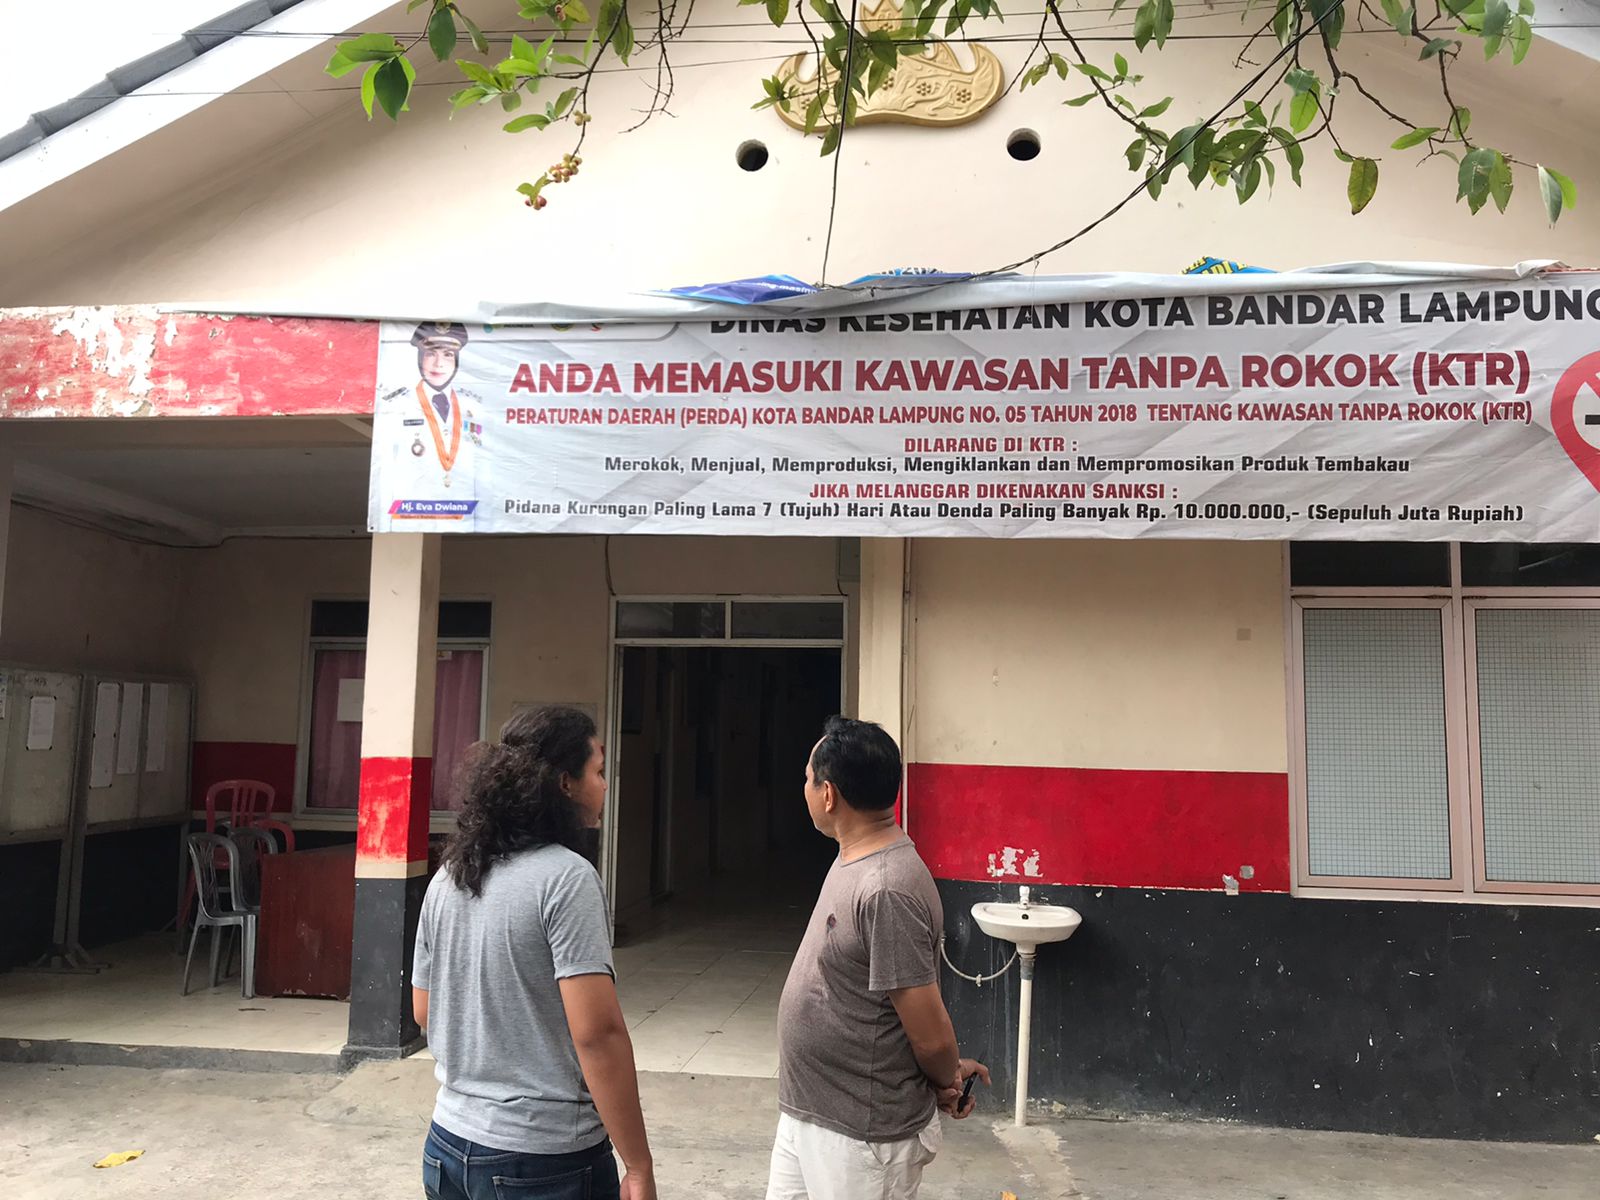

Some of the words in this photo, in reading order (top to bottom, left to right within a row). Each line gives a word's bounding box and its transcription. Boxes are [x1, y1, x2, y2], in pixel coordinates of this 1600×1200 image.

[838, 303, 1070, 332] KESEHATAN
[1084, 297, 1194, 328] KOTA
[1207, 294, 1385, 326] BANDAR
[508, 363, 622, 393] ANDA
[633, 360, 842, 393] MEMASUKI
[855, 358, 1069, 391] KAWASAN
[1081, 355, 1229, 389] TANPA
[1241, 353, 1400, 388] ROKOK
[1412, 350, 1531, 395] (KTR)
[505, 408, 603, 425] PERATURAN
[607, 408, 676, 425] DAERAH
[680, 407, 748, 429] (PERDA)
[752, 407, 798, 424] KOTA
[801, 407, 874, 424] BANDAR
[879, 406, 965, 424] LAMPUNG
[969, 406, 1001, 423] NO.
[1004, 406, 1027, 423] 05
[1031, 405, 1093, 422] TAHUN
[1097, 404, 1138, 422] 2018
[1146, 404, 1232, 422] TENTANG
[1237, 404, 1333, 421] KAWASAN
[1338, 403, 1401, 421] TANPA
[1407, 402, 1477, 421] ROKOK
[1481, 401, 1533, 425] (KTR)
[904, 438, 998, 453] DILARANG
[1003, 437, 1023, 452] DI
[1029, 437, 1065, 452] KTR
[604, 457, 685, 474] Merokok,
[691, 457, 765, 475] Menjual,
[772, 457, 898, 475] Memproduksi,
[903, 456, 1031, 475] Mengiklankan
[1037, 456, 1070, 471] dan
[1076, 456, 1235, 474] Mempromosikan
[1241, 456, 1310, 471] Produk
[1315, 456, 1410, 472] Tembakau
[809, 484, 850, 499] JIKA
[856, 484, 970, 499] MELANGGAR
[976, 484, 1086, 499] DIKENAKAN
[1092, 484, 1165, 499] SANKSI
[401, 502, 414, 512] Hj.
[416, 502, 433, 511] Eva
[434, 502, 469, 511] Dwiana
[504, 500, 561, 514] Pidana
[567, 500, 648, 518] Kurungan
[653, 501, 706, 519] Paling
[711, 502, 756, 517] Lama
[762, 502, 772, 517] 7
[780, 502, 840, 520] (Tujuh)
[846, 503, 884, 518] Hari
[890, 503, 931, 518] Atau
[937, 503, 993, 518] Denda
[999, 503, 1056, 521] Paling
[1062, 503, 1131, 522] Banyak
[1136, 504, 1167, 523] Rp.
[1173, 503, 1300, 522] 10.000.000,-
[1307, 504, 1392, 523] (Sepuluh
[1398, 505, 1441, 521] Juta
[1447, 505, 1524, 524] Rupiah)
